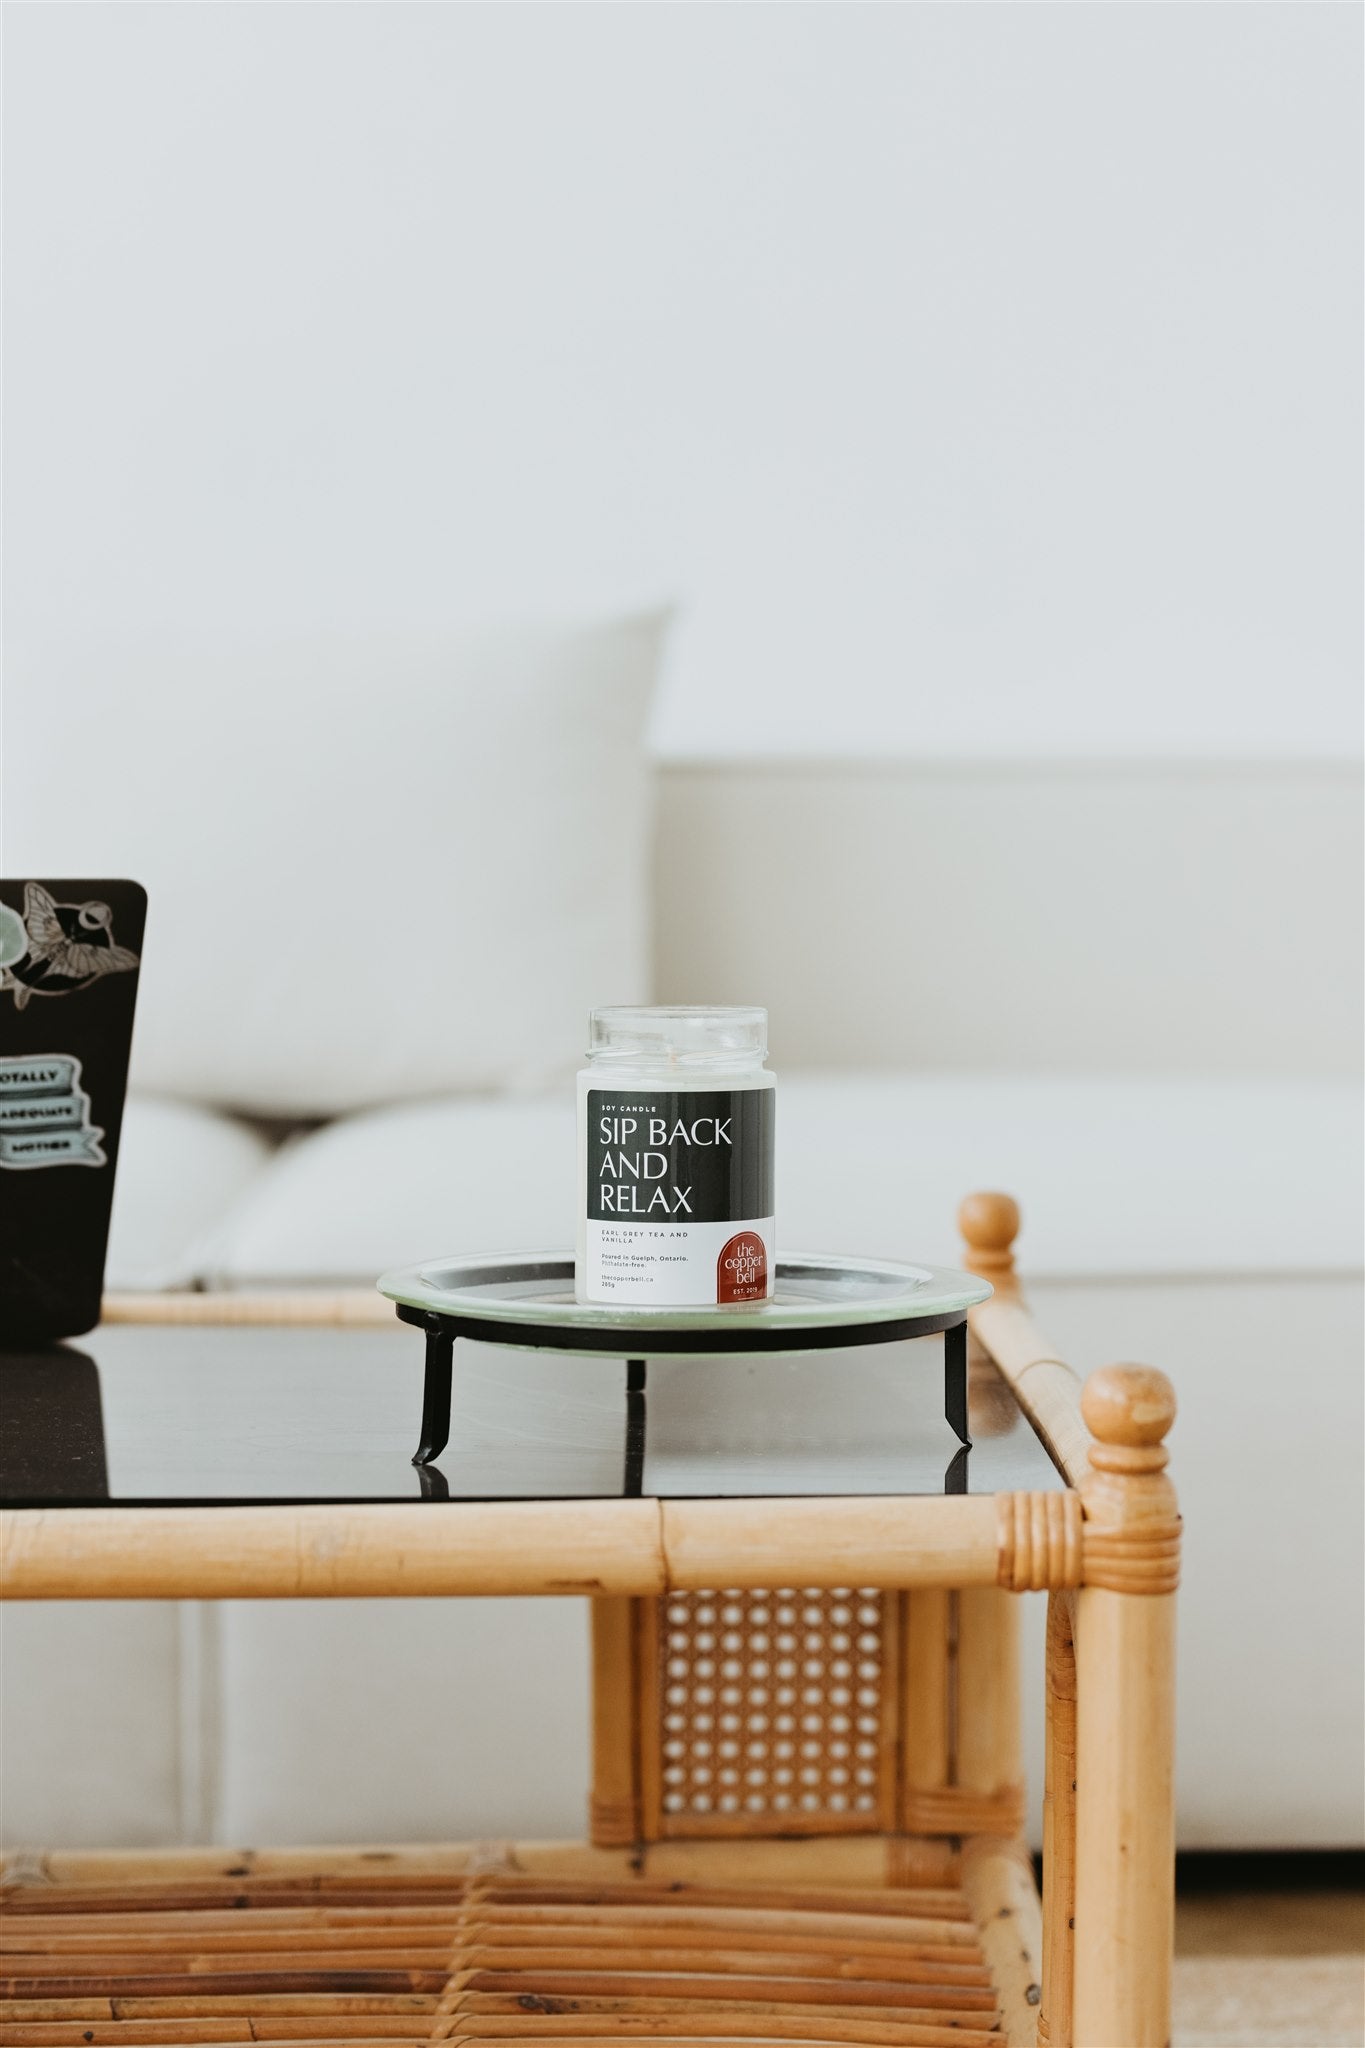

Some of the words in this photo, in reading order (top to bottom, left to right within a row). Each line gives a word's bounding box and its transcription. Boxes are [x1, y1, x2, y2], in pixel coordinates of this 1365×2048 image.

[620, 1105, 656, 1113] CANDLE
[600, 1116, 638, 1145] SIP
[649, 1118, 732, 1146] BACK
[600, 1150, 668, 1180] AND
[600, 1184, 693, 1213] RELAX
[737, 1242, 755, 1258] the
[725, 1256, 763, 1272] copper
[601, 1274, 654, 1282] thecopperbell.ca
[736, 1267, 755, 1284] bell
